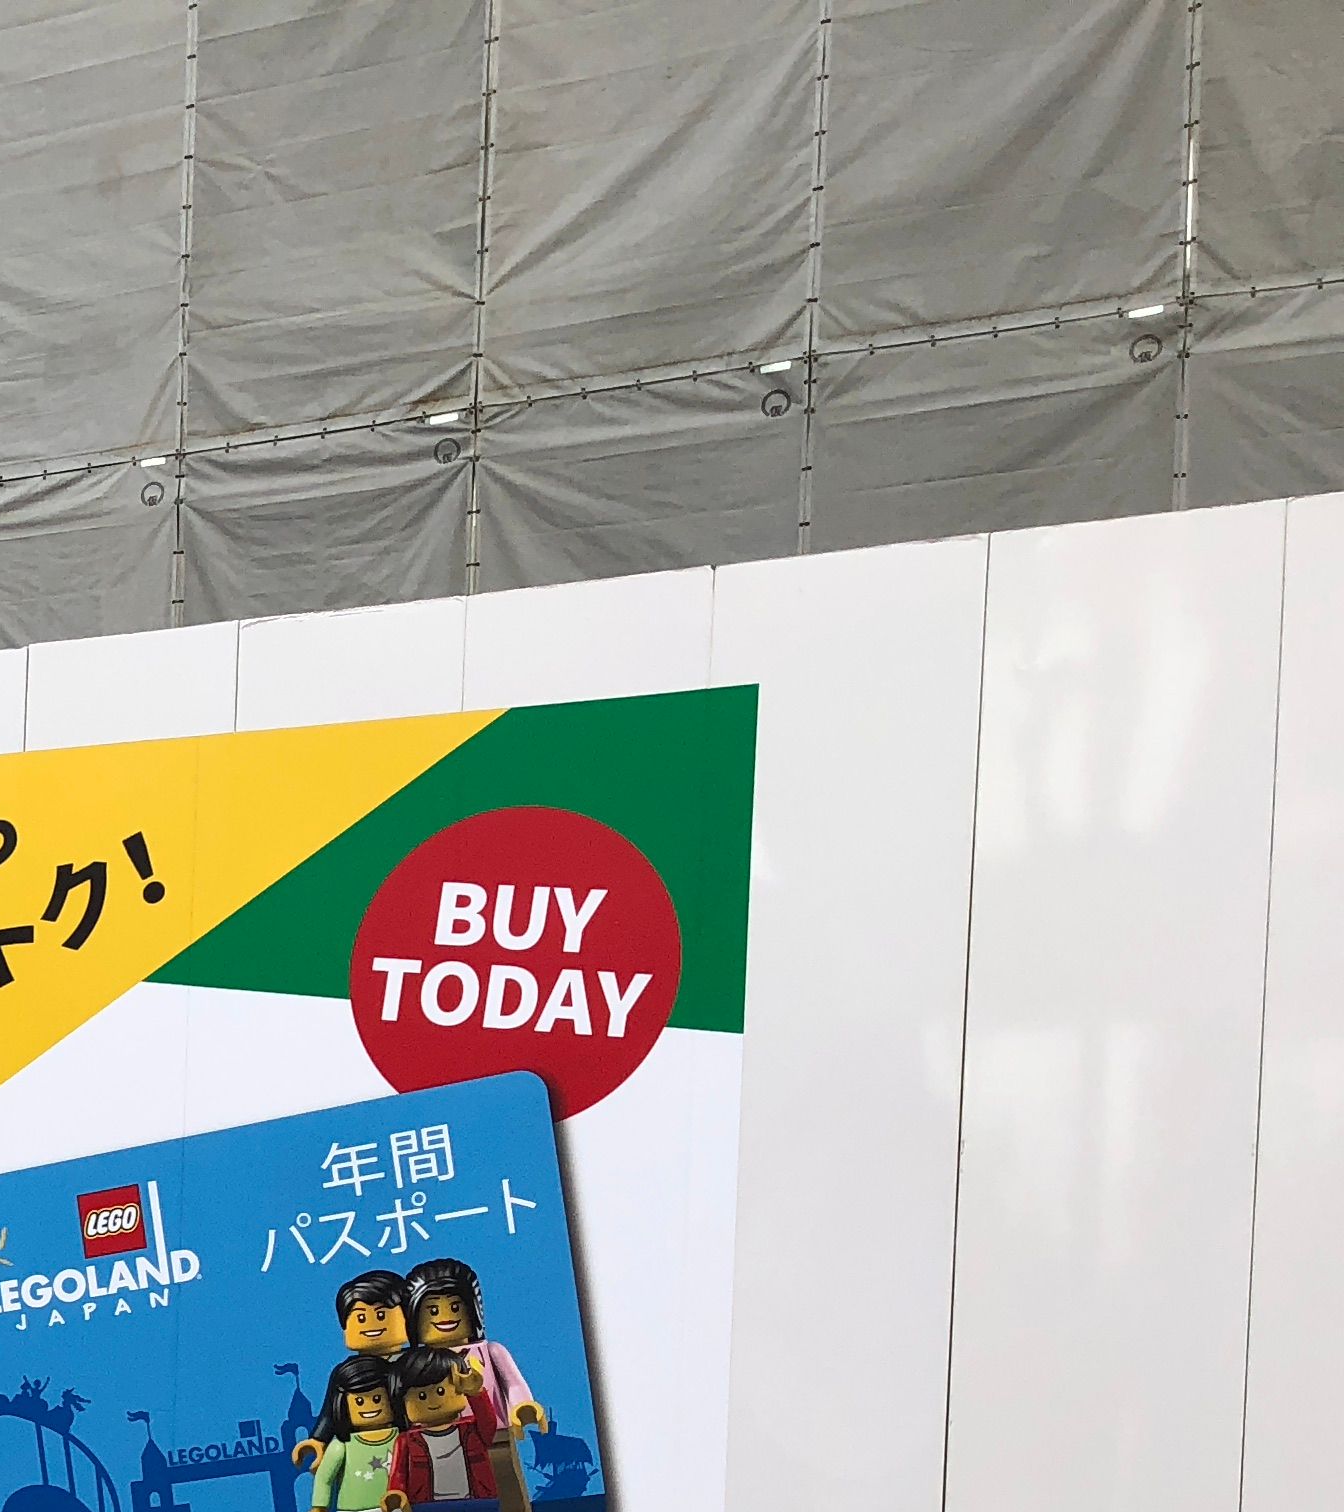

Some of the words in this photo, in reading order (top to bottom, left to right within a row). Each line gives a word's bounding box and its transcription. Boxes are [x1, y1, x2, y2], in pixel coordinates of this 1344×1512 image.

[434, 881, 609, 953] BUY
[372, 957, 653, 1038] TODAY
[320, 1123, 455, 1198] 年間
[84, 1204, 139, 1238] LEGO
[260, 1178, 537, 1273] パスポート
[15, 1288, 170, 1331] JAPAN
[167, 1419, 280, 1466] LEGOLAND
